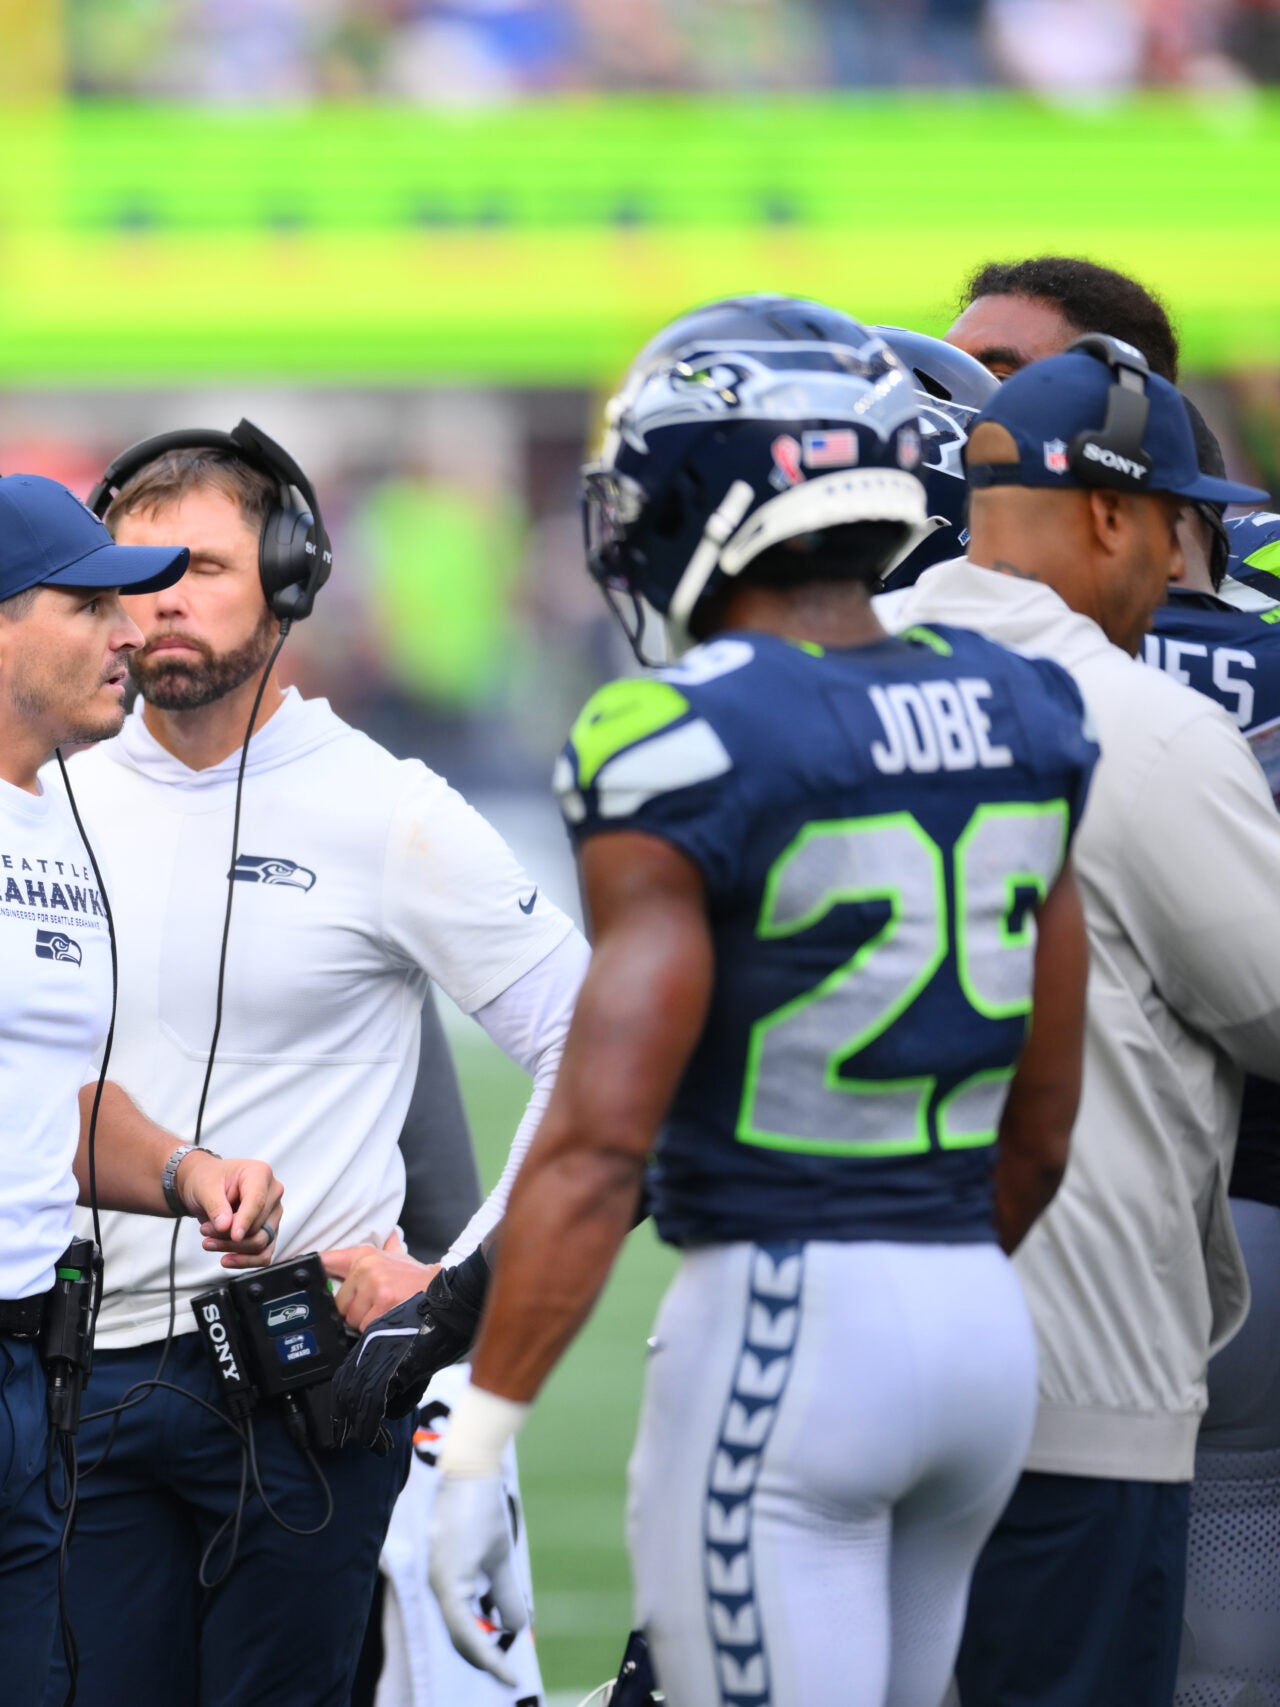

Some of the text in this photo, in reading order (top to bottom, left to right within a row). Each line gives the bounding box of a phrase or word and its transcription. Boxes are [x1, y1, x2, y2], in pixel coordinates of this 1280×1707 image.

[1083, 442, 1148, 480] SONY
[867, 677, 1014, 775] JOBE
[37, 913, 49, 923] FOR
[50, 914, 74, 926] SEATTLE
[734, 797, 1070, 1158] 29
[202, 1303, 241, 1382] SONY
